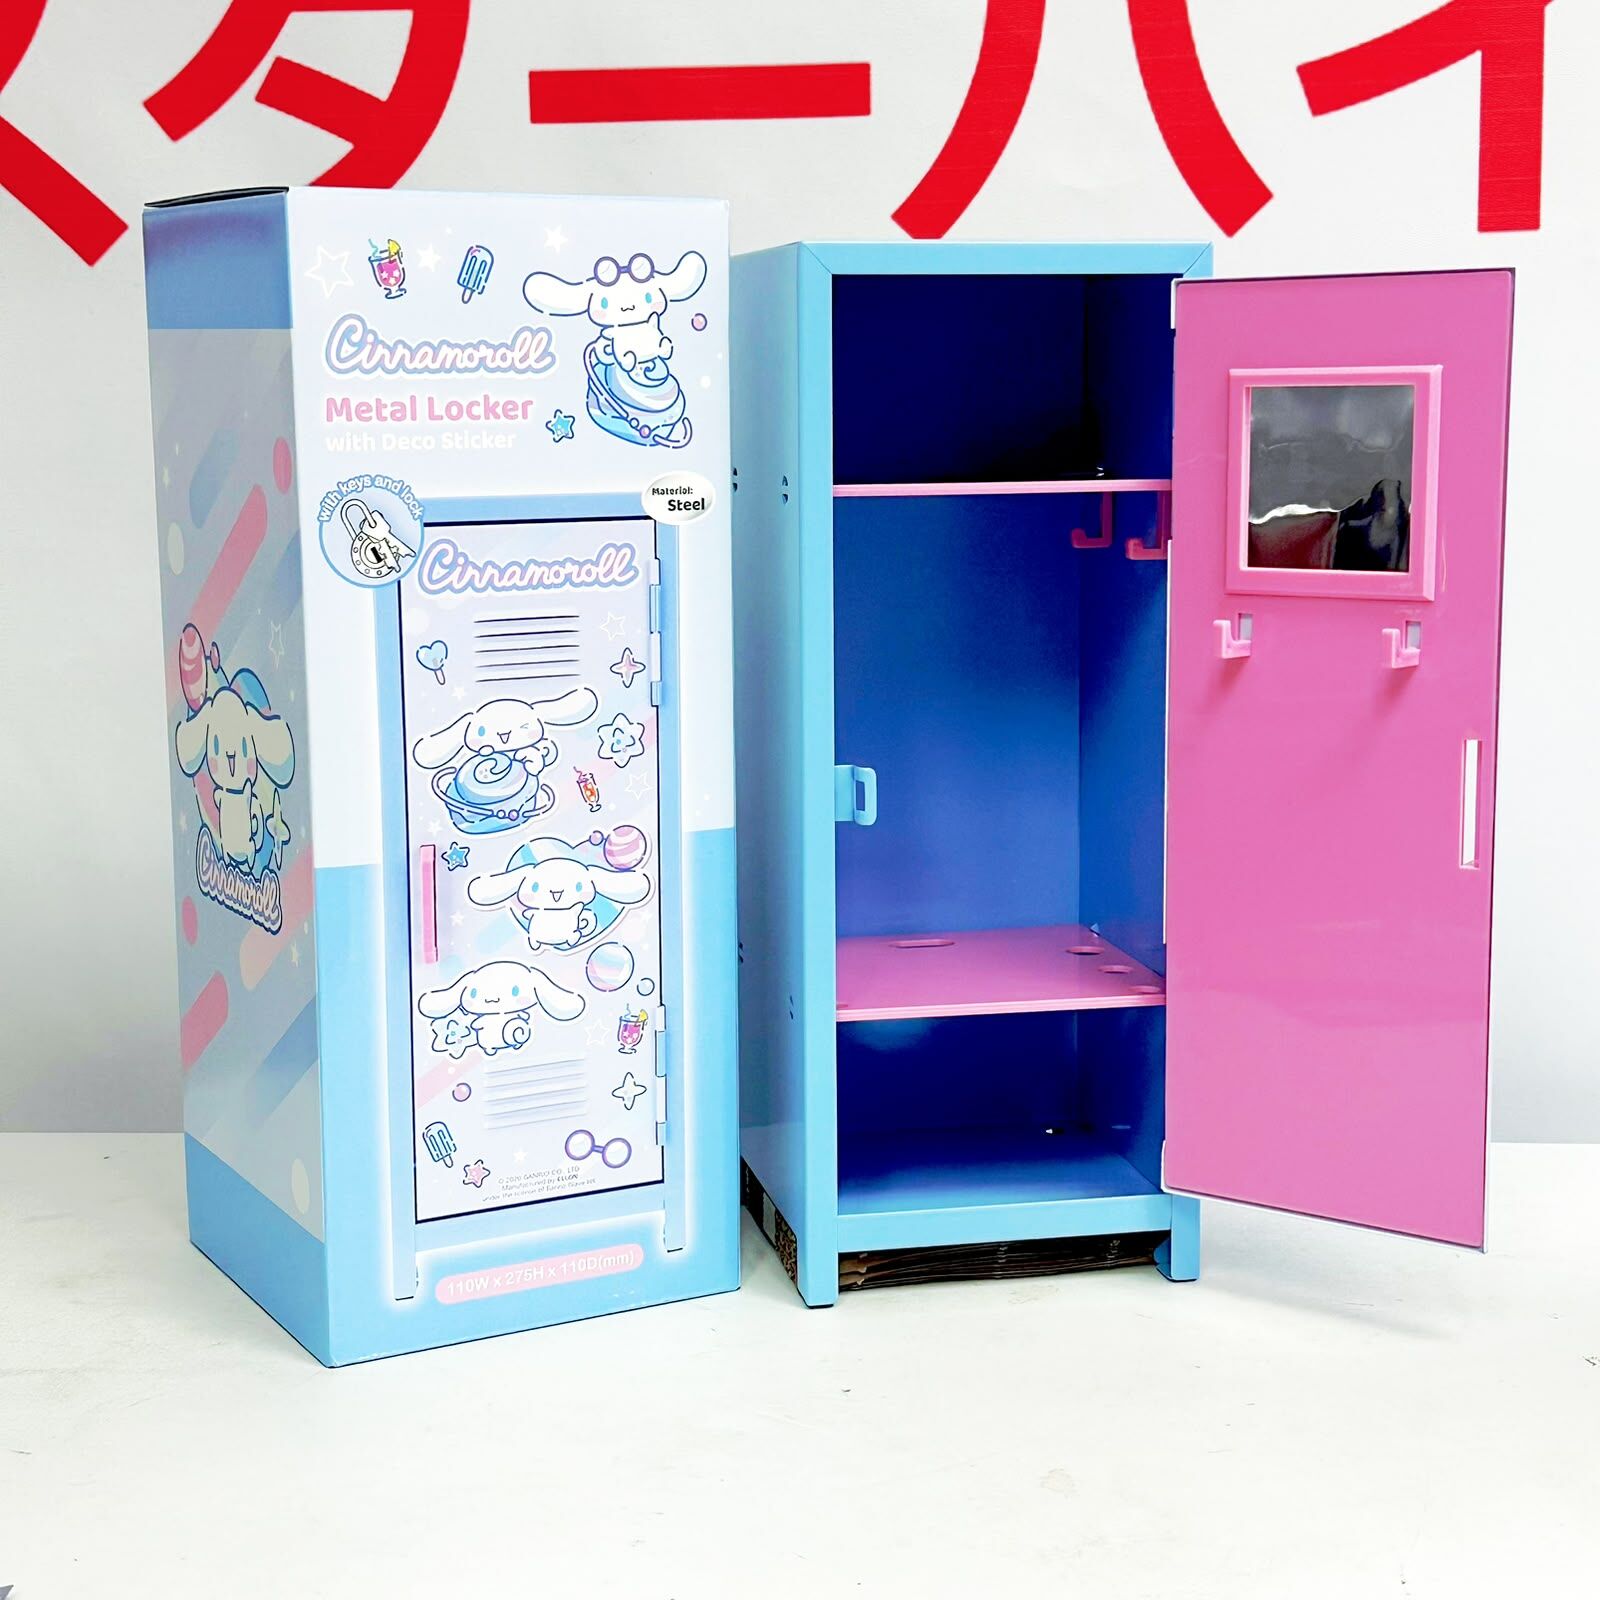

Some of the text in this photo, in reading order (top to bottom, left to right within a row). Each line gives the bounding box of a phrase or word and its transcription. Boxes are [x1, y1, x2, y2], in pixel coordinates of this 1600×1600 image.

[325, 313, 556, 375] Cinnamoroll
[325, 393, 534, 423] Metal Locker
[325, 430, 517, 452] with Deco Sticker
[318, 474, 424, 522] with keys and lock
[652, 486, 694, 496] Material:
[667, 497, 705, 512] Steel
[418, 538, 640, 596] Cinnamoroll
[199, 829, 281, 926] Cinnamoroll
[448, 1251, 635, 1297] 110W x 275H x 110D(mm)
